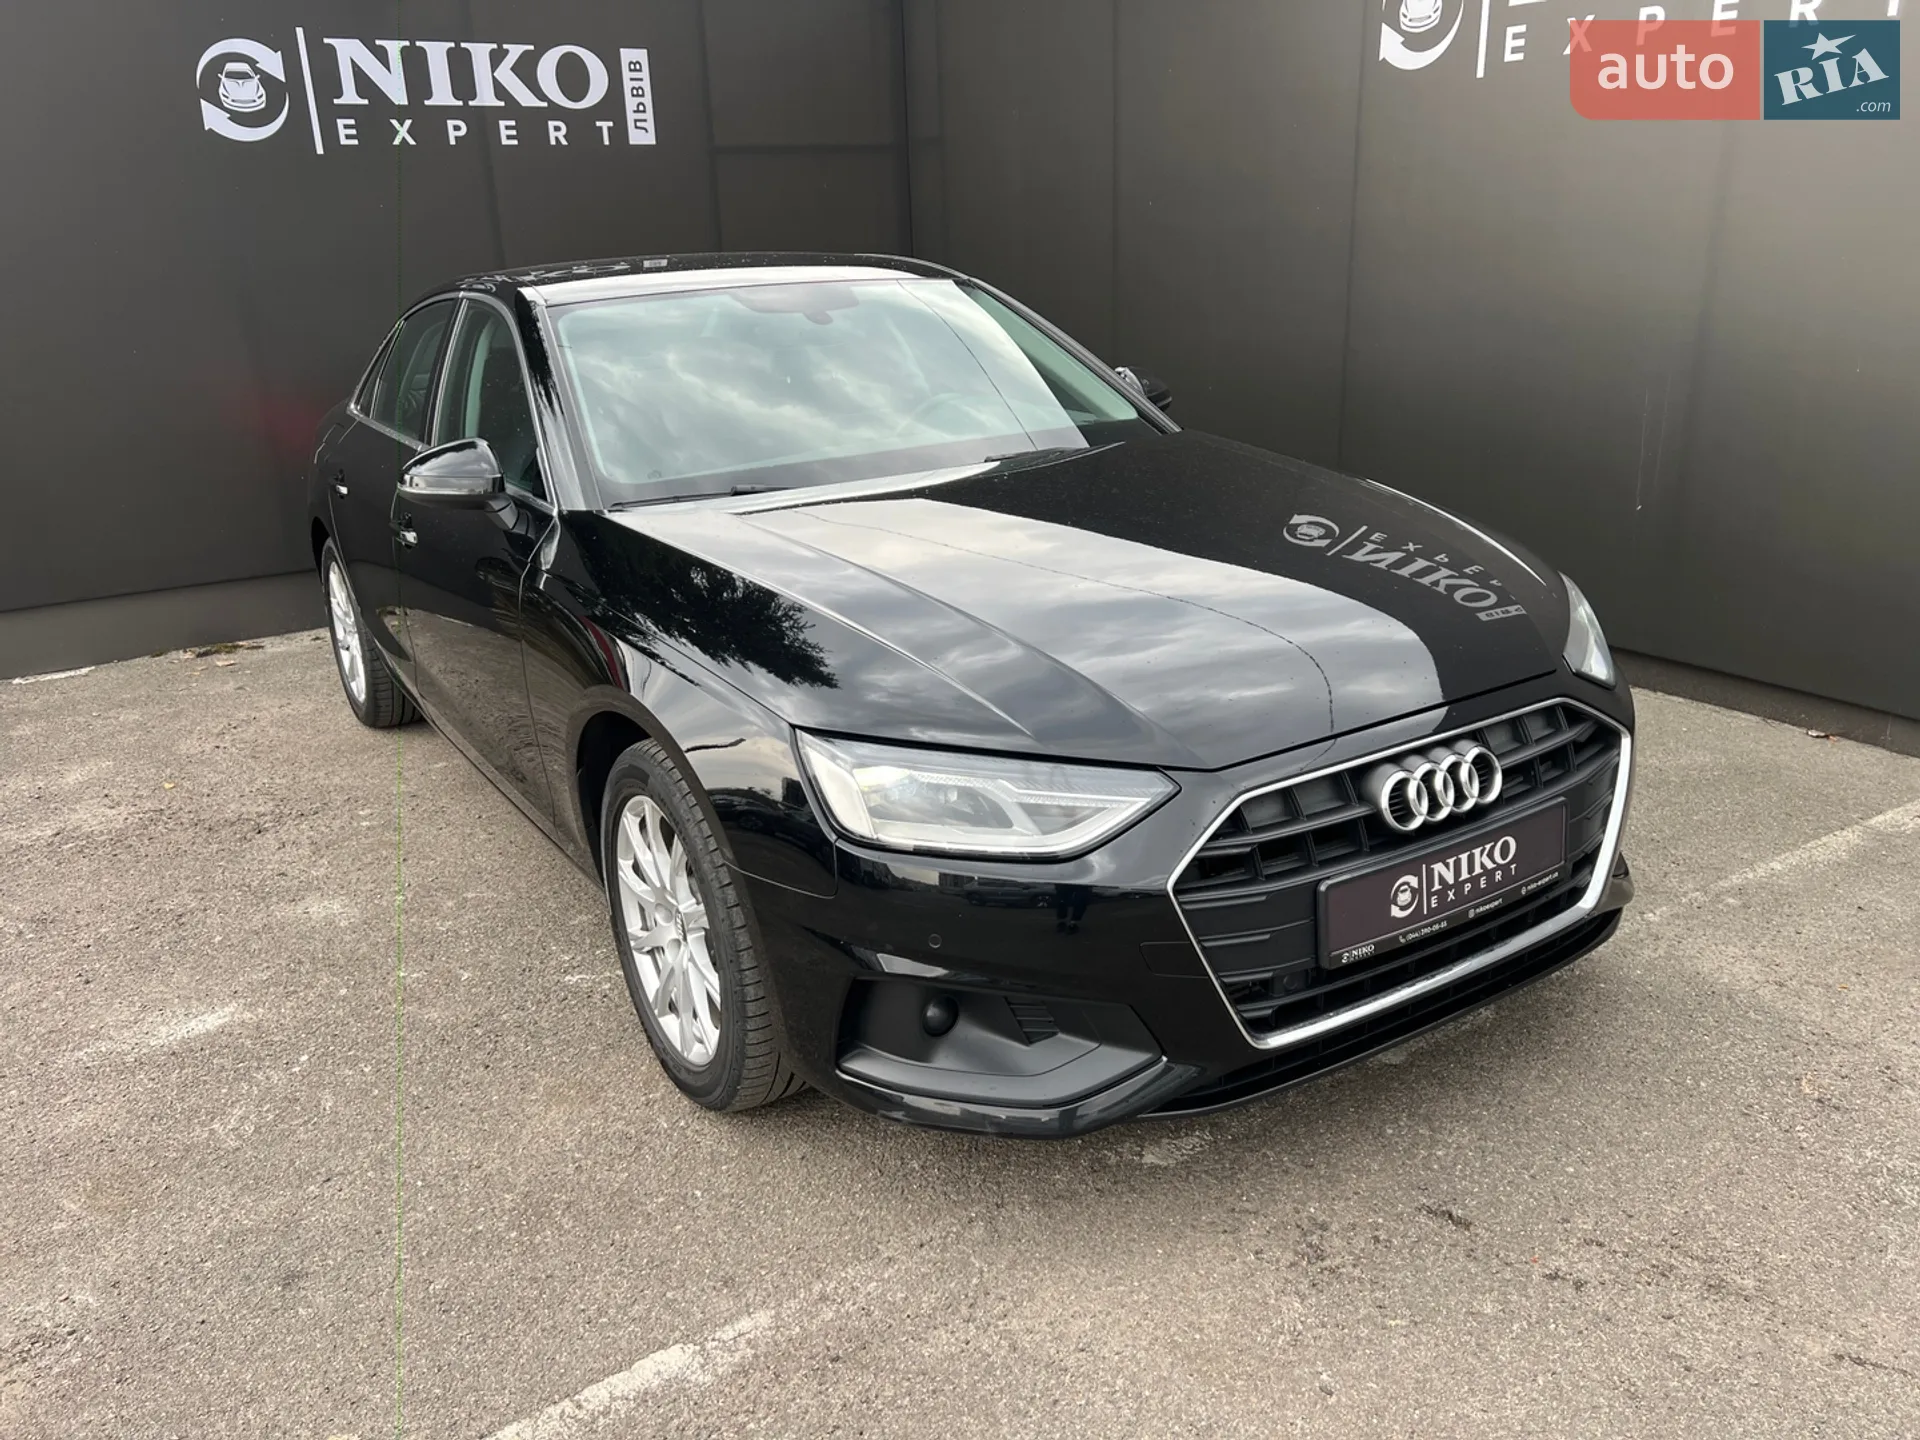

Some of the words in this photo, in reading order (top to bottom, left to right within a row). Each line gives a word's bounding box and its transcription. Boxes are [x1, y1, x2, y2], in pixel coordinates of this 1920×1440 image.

[323, 37, 609, 109] NIKO
[628, 59, 649, 133] ЛЬВІВ
[336, 118, 614, 147] EXPERT
[1431, 836, 1516, 891] NIKO
[1431, 863, 1518, 908] EXPERT
[1352, 944, 1375, 957] NIKO
